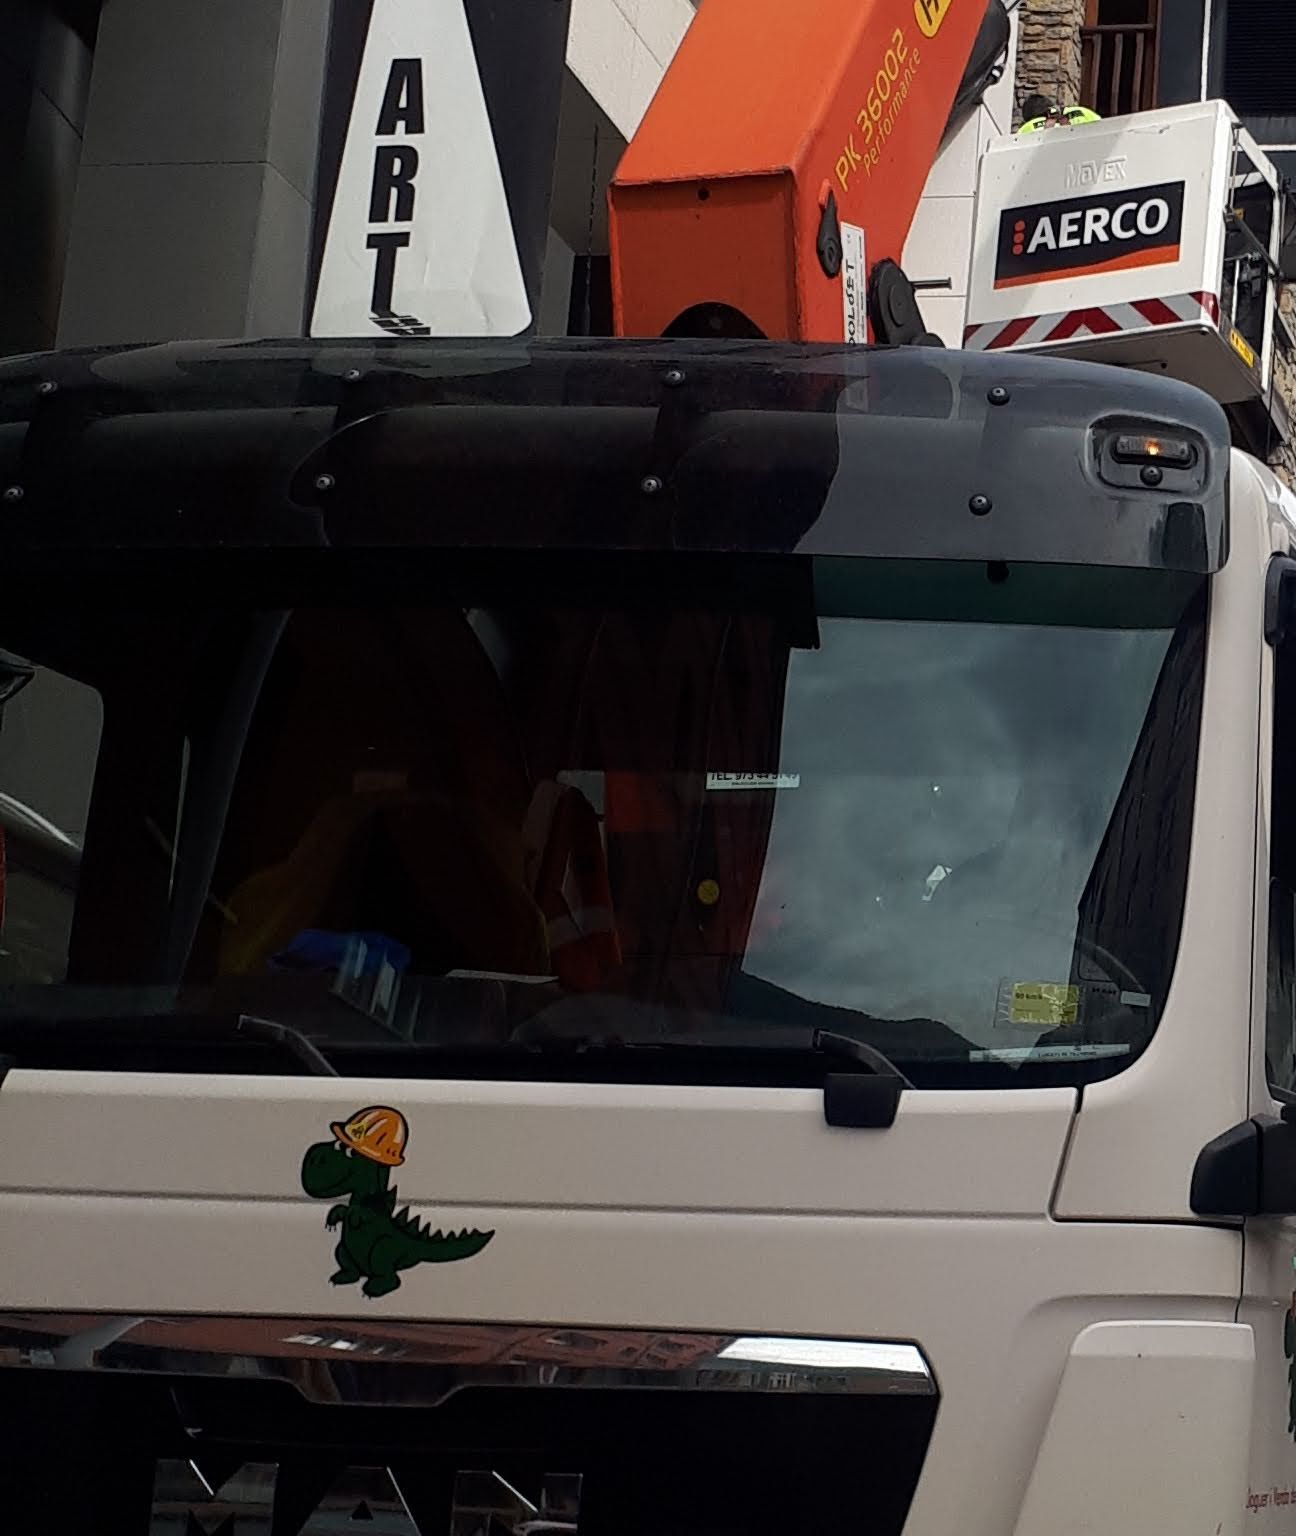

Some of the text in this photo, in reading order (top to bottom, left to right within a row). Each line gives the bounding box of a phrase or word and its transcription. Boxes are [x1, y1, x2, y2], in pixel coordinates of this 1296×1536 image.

[835, 27, 908, 193] PK 36002
[862, 47, 921, 178] performance
[366, 58, 430, 335] ART
[1026, 198, 1170, 254] AERCO
